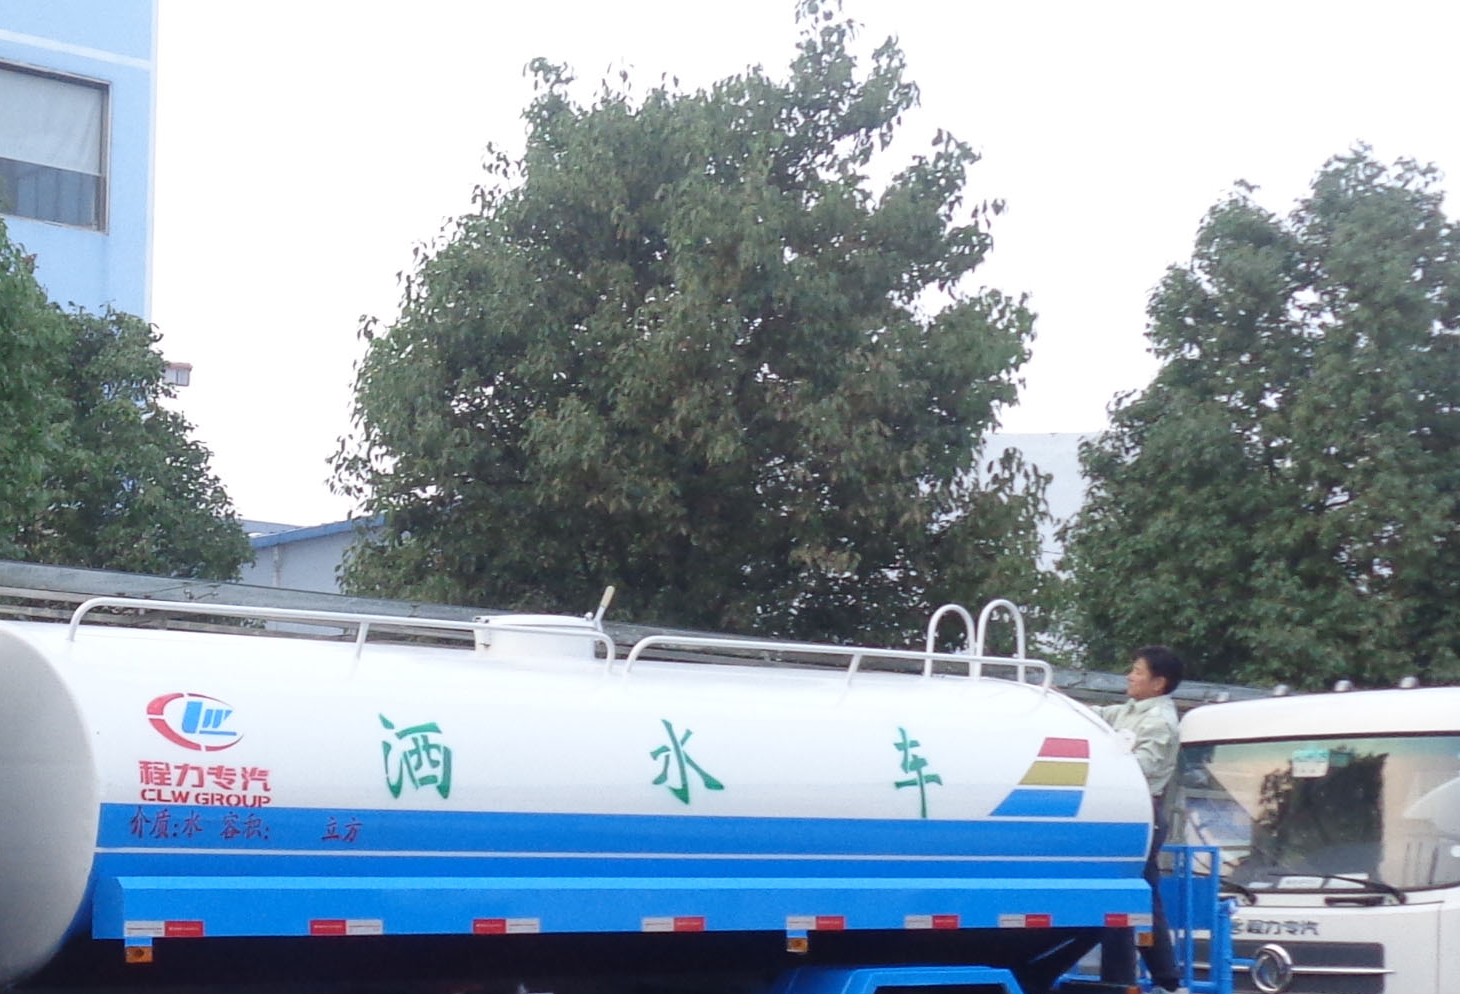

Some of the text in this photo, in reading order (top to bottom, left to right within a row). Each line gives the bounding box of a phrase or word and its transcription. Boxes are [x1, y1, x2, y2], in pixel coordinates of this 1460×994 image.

[138, 760, 272, 792] 程力专汽
[141, 788, 272, 808] CLW GROUP
